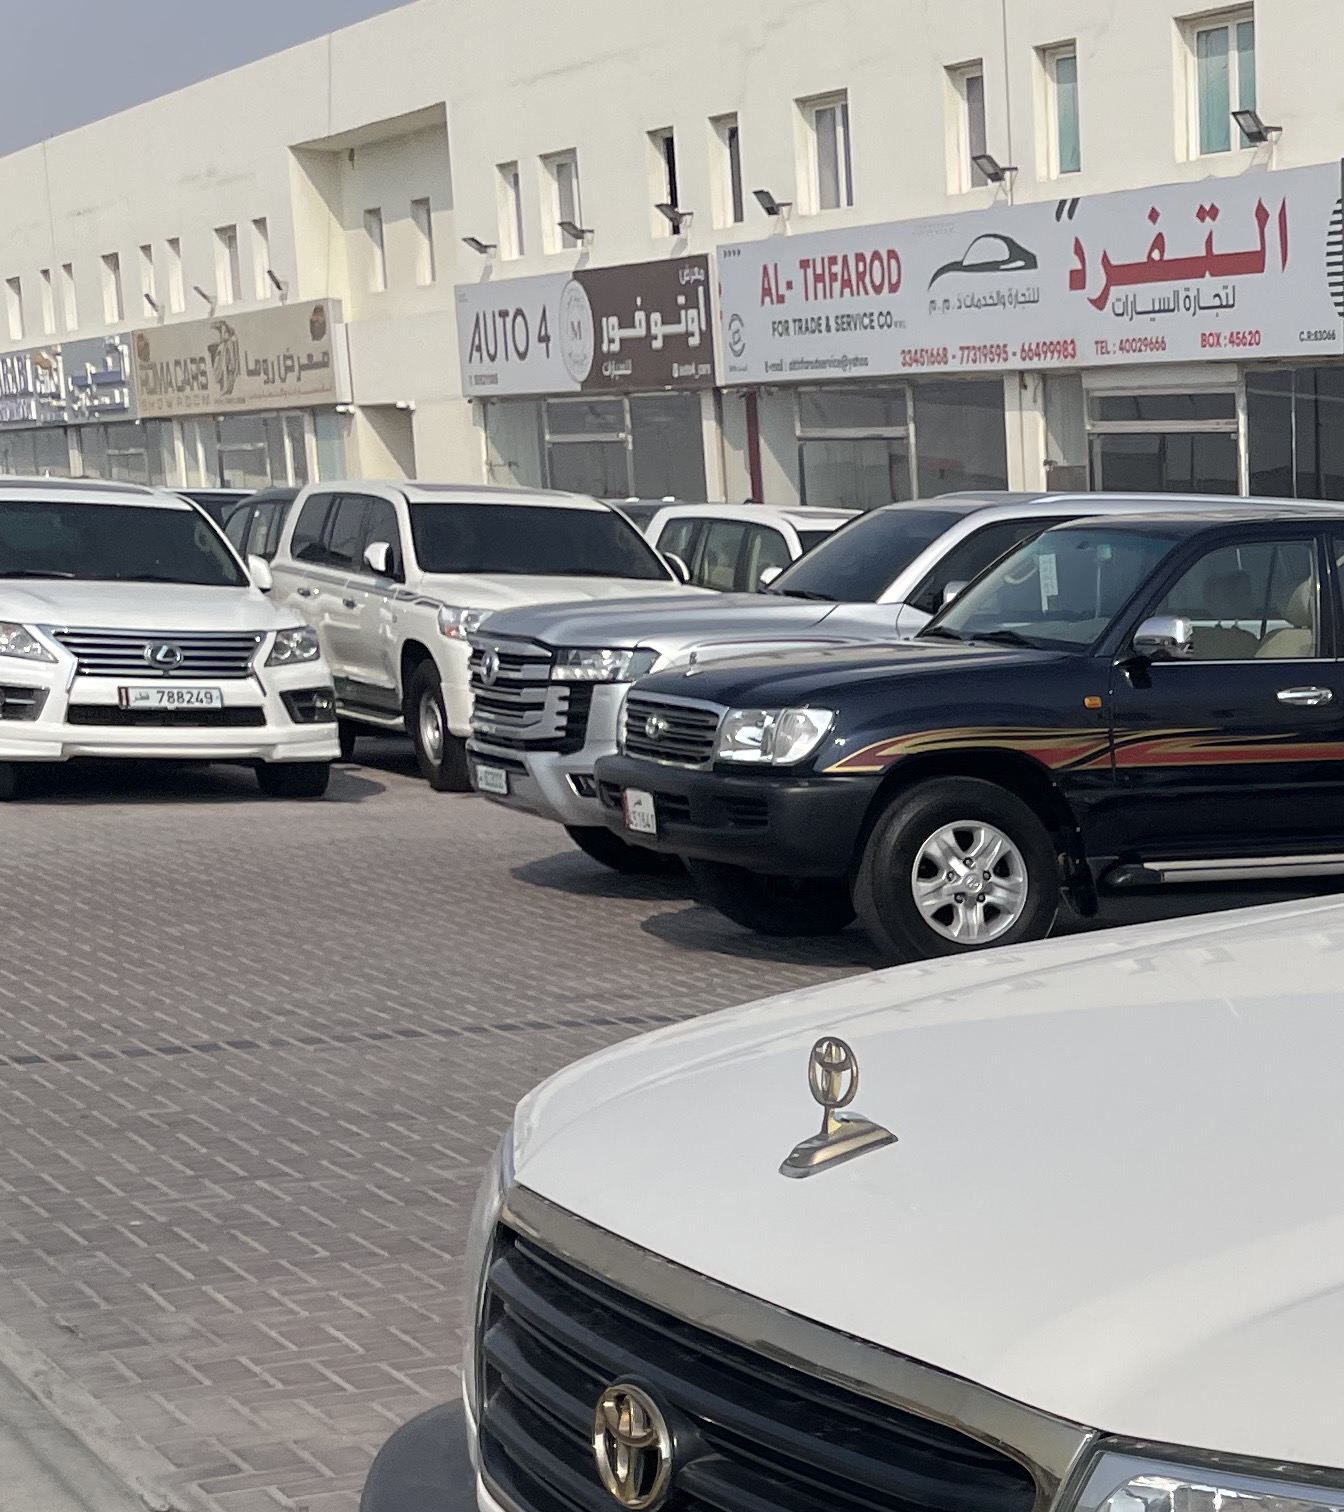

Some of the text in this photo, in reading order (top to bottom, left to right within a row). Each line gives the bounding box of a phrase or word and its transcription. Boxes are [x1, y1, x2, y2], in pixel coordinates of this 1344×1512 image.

[799, 249, 902, 302] THFAROD
[1068, 196, 1289, 311] التفرد
[469, 304, 551, 364] AUTO 4
[772, 319, 790, 339] FOR
[793, 315, 822, 336] TRADE
[834, 311, 875, 333] SERVICE
[156, 690, 213, 705] 788249
